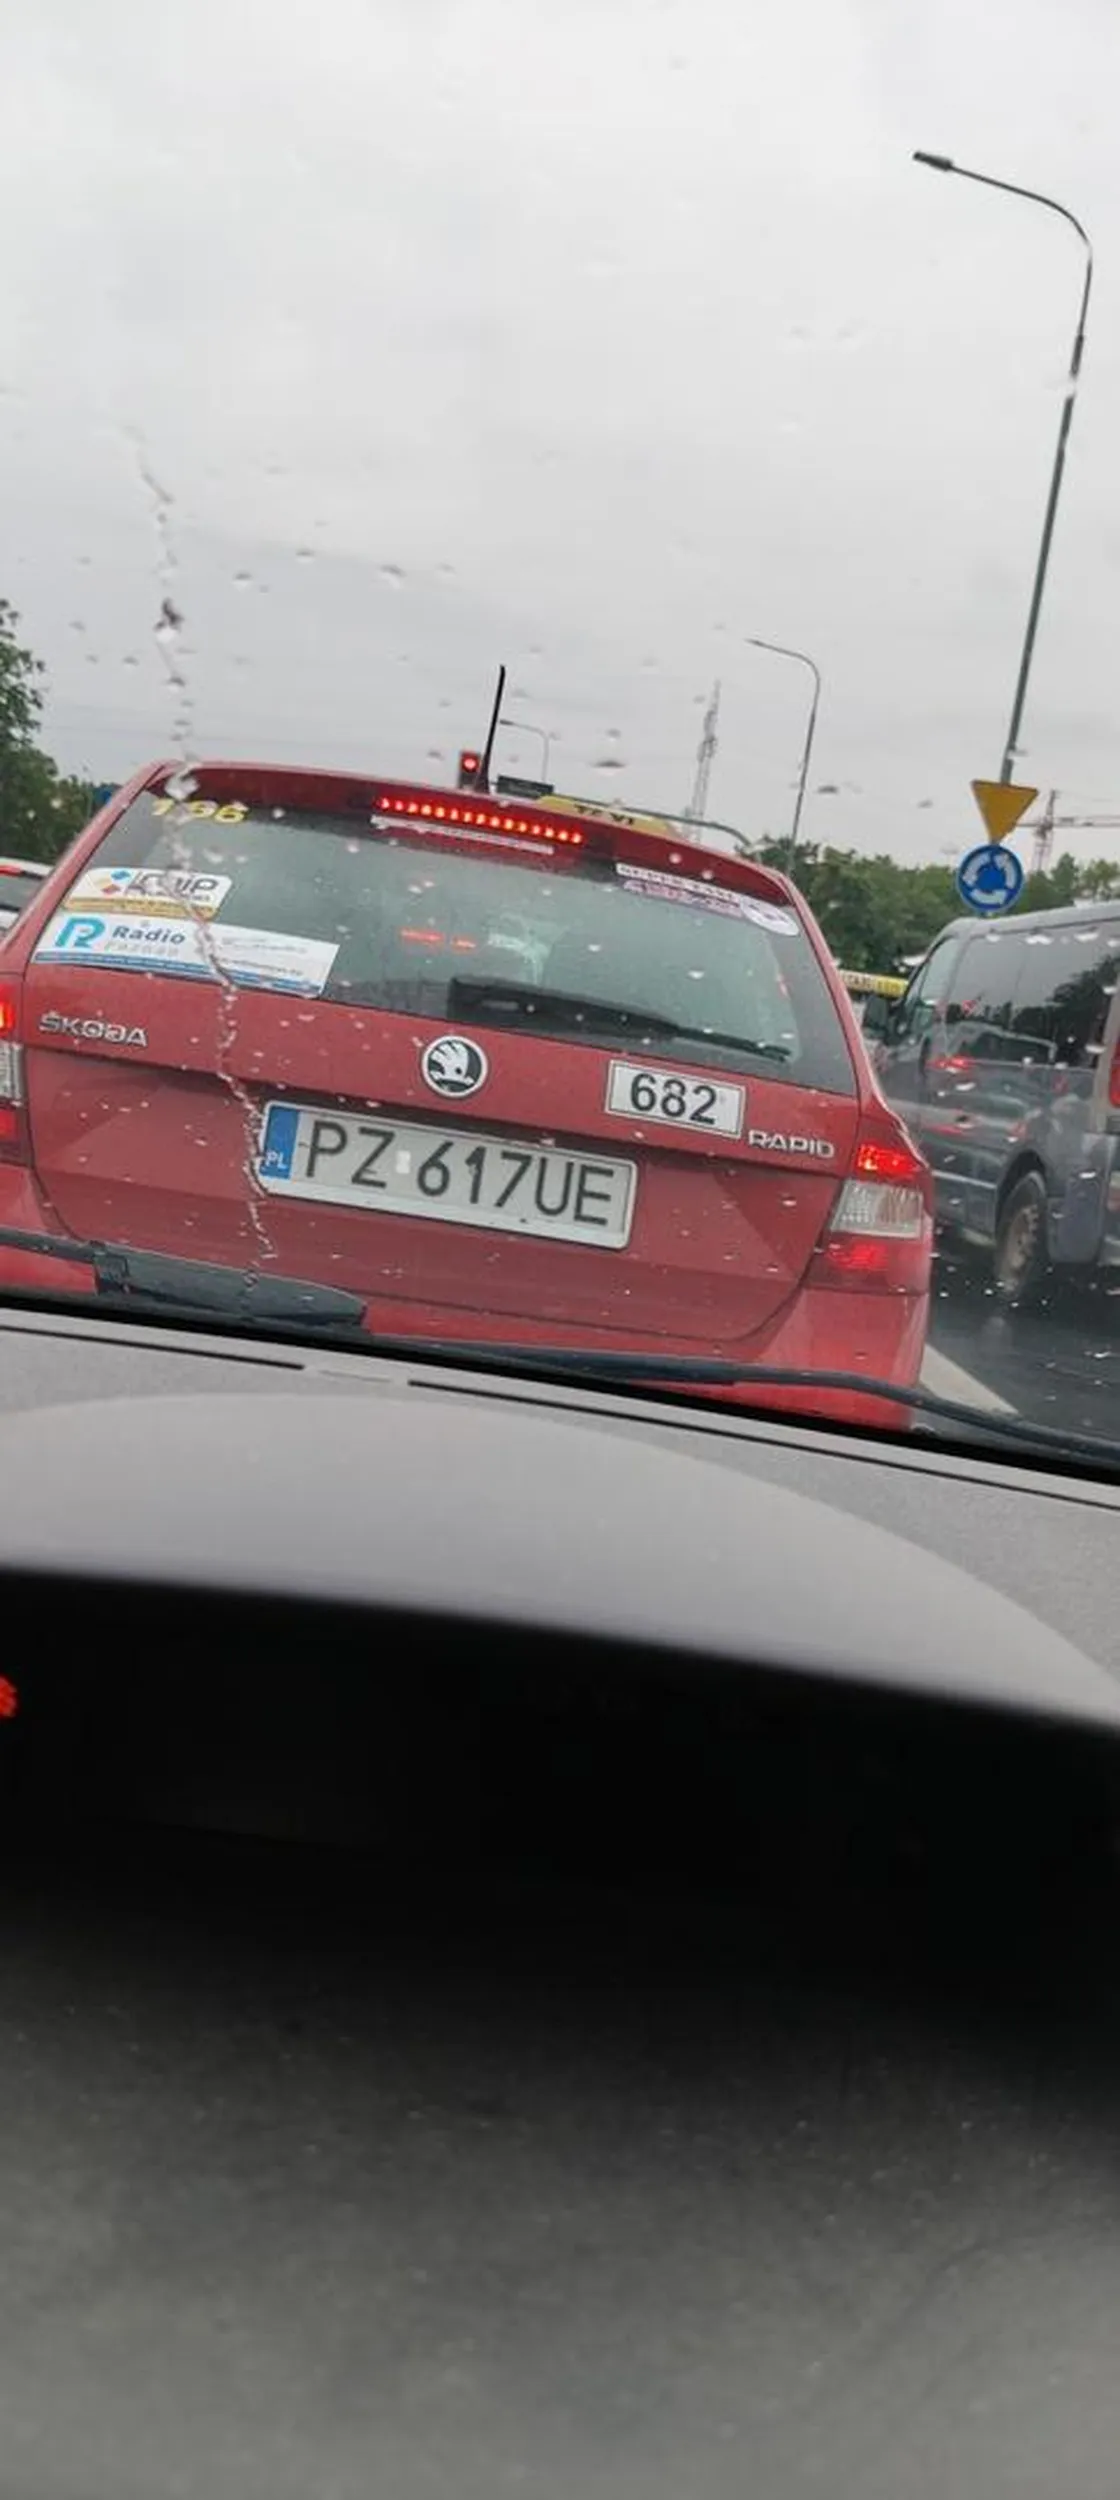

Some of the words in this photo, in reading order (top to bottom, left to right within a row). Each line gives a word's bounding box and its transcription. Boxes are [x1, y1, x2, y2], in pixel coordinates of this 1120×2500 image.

[112, 924, 187, 945] Radio
[38, 1010, 148, 1047] ŠKODA
[630, 1073, 718, 1126] 682
[264, 1149, 289, 1171] PL
[748, 1129, 835, 1158] RAPID
[305, 1120, 396, 1190] PZ
[417, 1141, 615, 1226] 617UE
